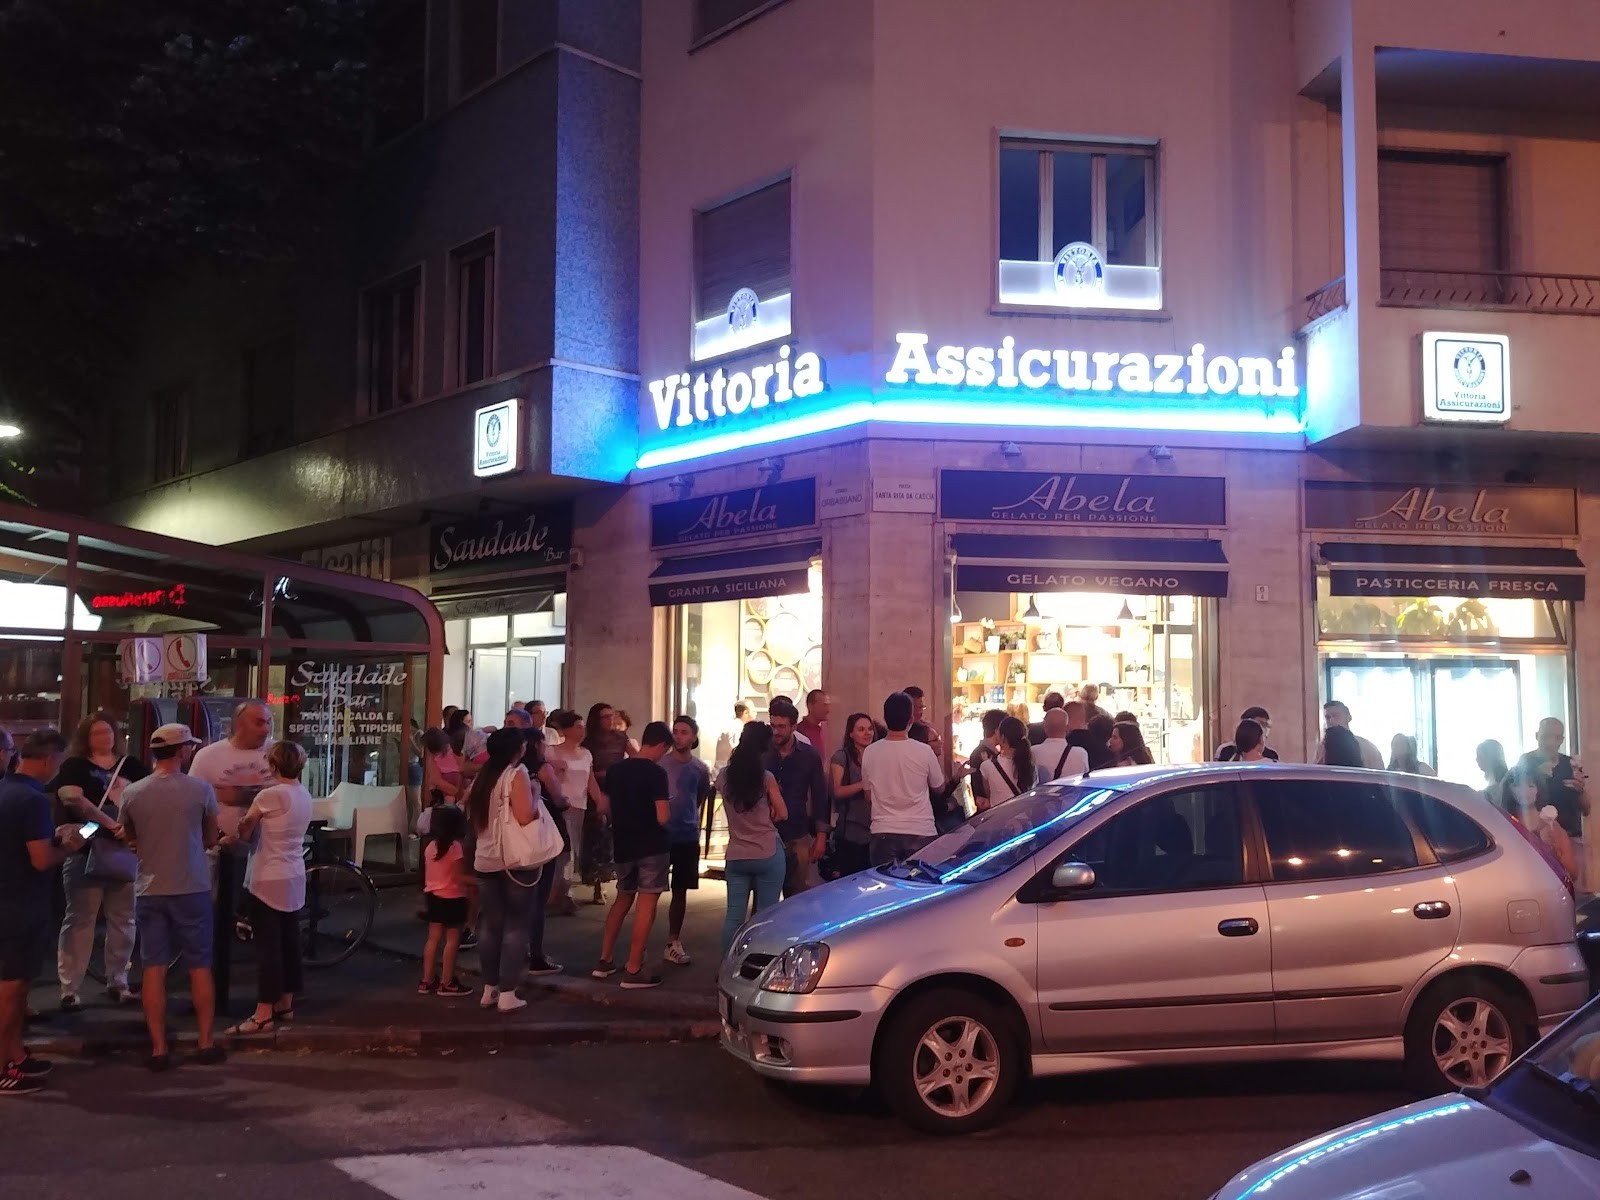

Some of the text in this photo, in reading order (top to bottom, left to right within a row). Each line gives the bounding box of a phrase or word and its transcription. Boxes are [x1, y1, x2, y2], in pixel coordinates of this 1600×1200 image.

[885, 332, 1299, 397] Assicurazioni
[648, 344, 824, 431] Vittoria
[1454, 391, 1486, 400] Vittoria
[1439, 398, 1501, 409] Assicurazioni
[875, 491, 891, 499] SANTA
[893, 492, 904, 500] RITA
[906, 492, 913, 500] DA
[991, 475, 1158, 513] Abela
[678, 489, 777, 535] Abela
[1356, 487, 1512, 524] Abela
[991, 510, 1158, 523] GELATO PER PASSIONE
[734, 522, 778, 536] PASSIONE
[433, 514, 565, 570] Saudade Bar
[668, 577, 787, 598] GRANITA SICILIANA
[1006, 573, 1179, 589] GELATO VEGANO
[1356, 577, 1559, 592] PASTICCERIA FRESCA
[291, 660, 408, 686] Saudade
[322, 686, 375, 708] Bar
[348, 711, 384, 721] CALDA
[387, 712, 394, 721] E
[359, 723, 403, 734] TIPICHE
